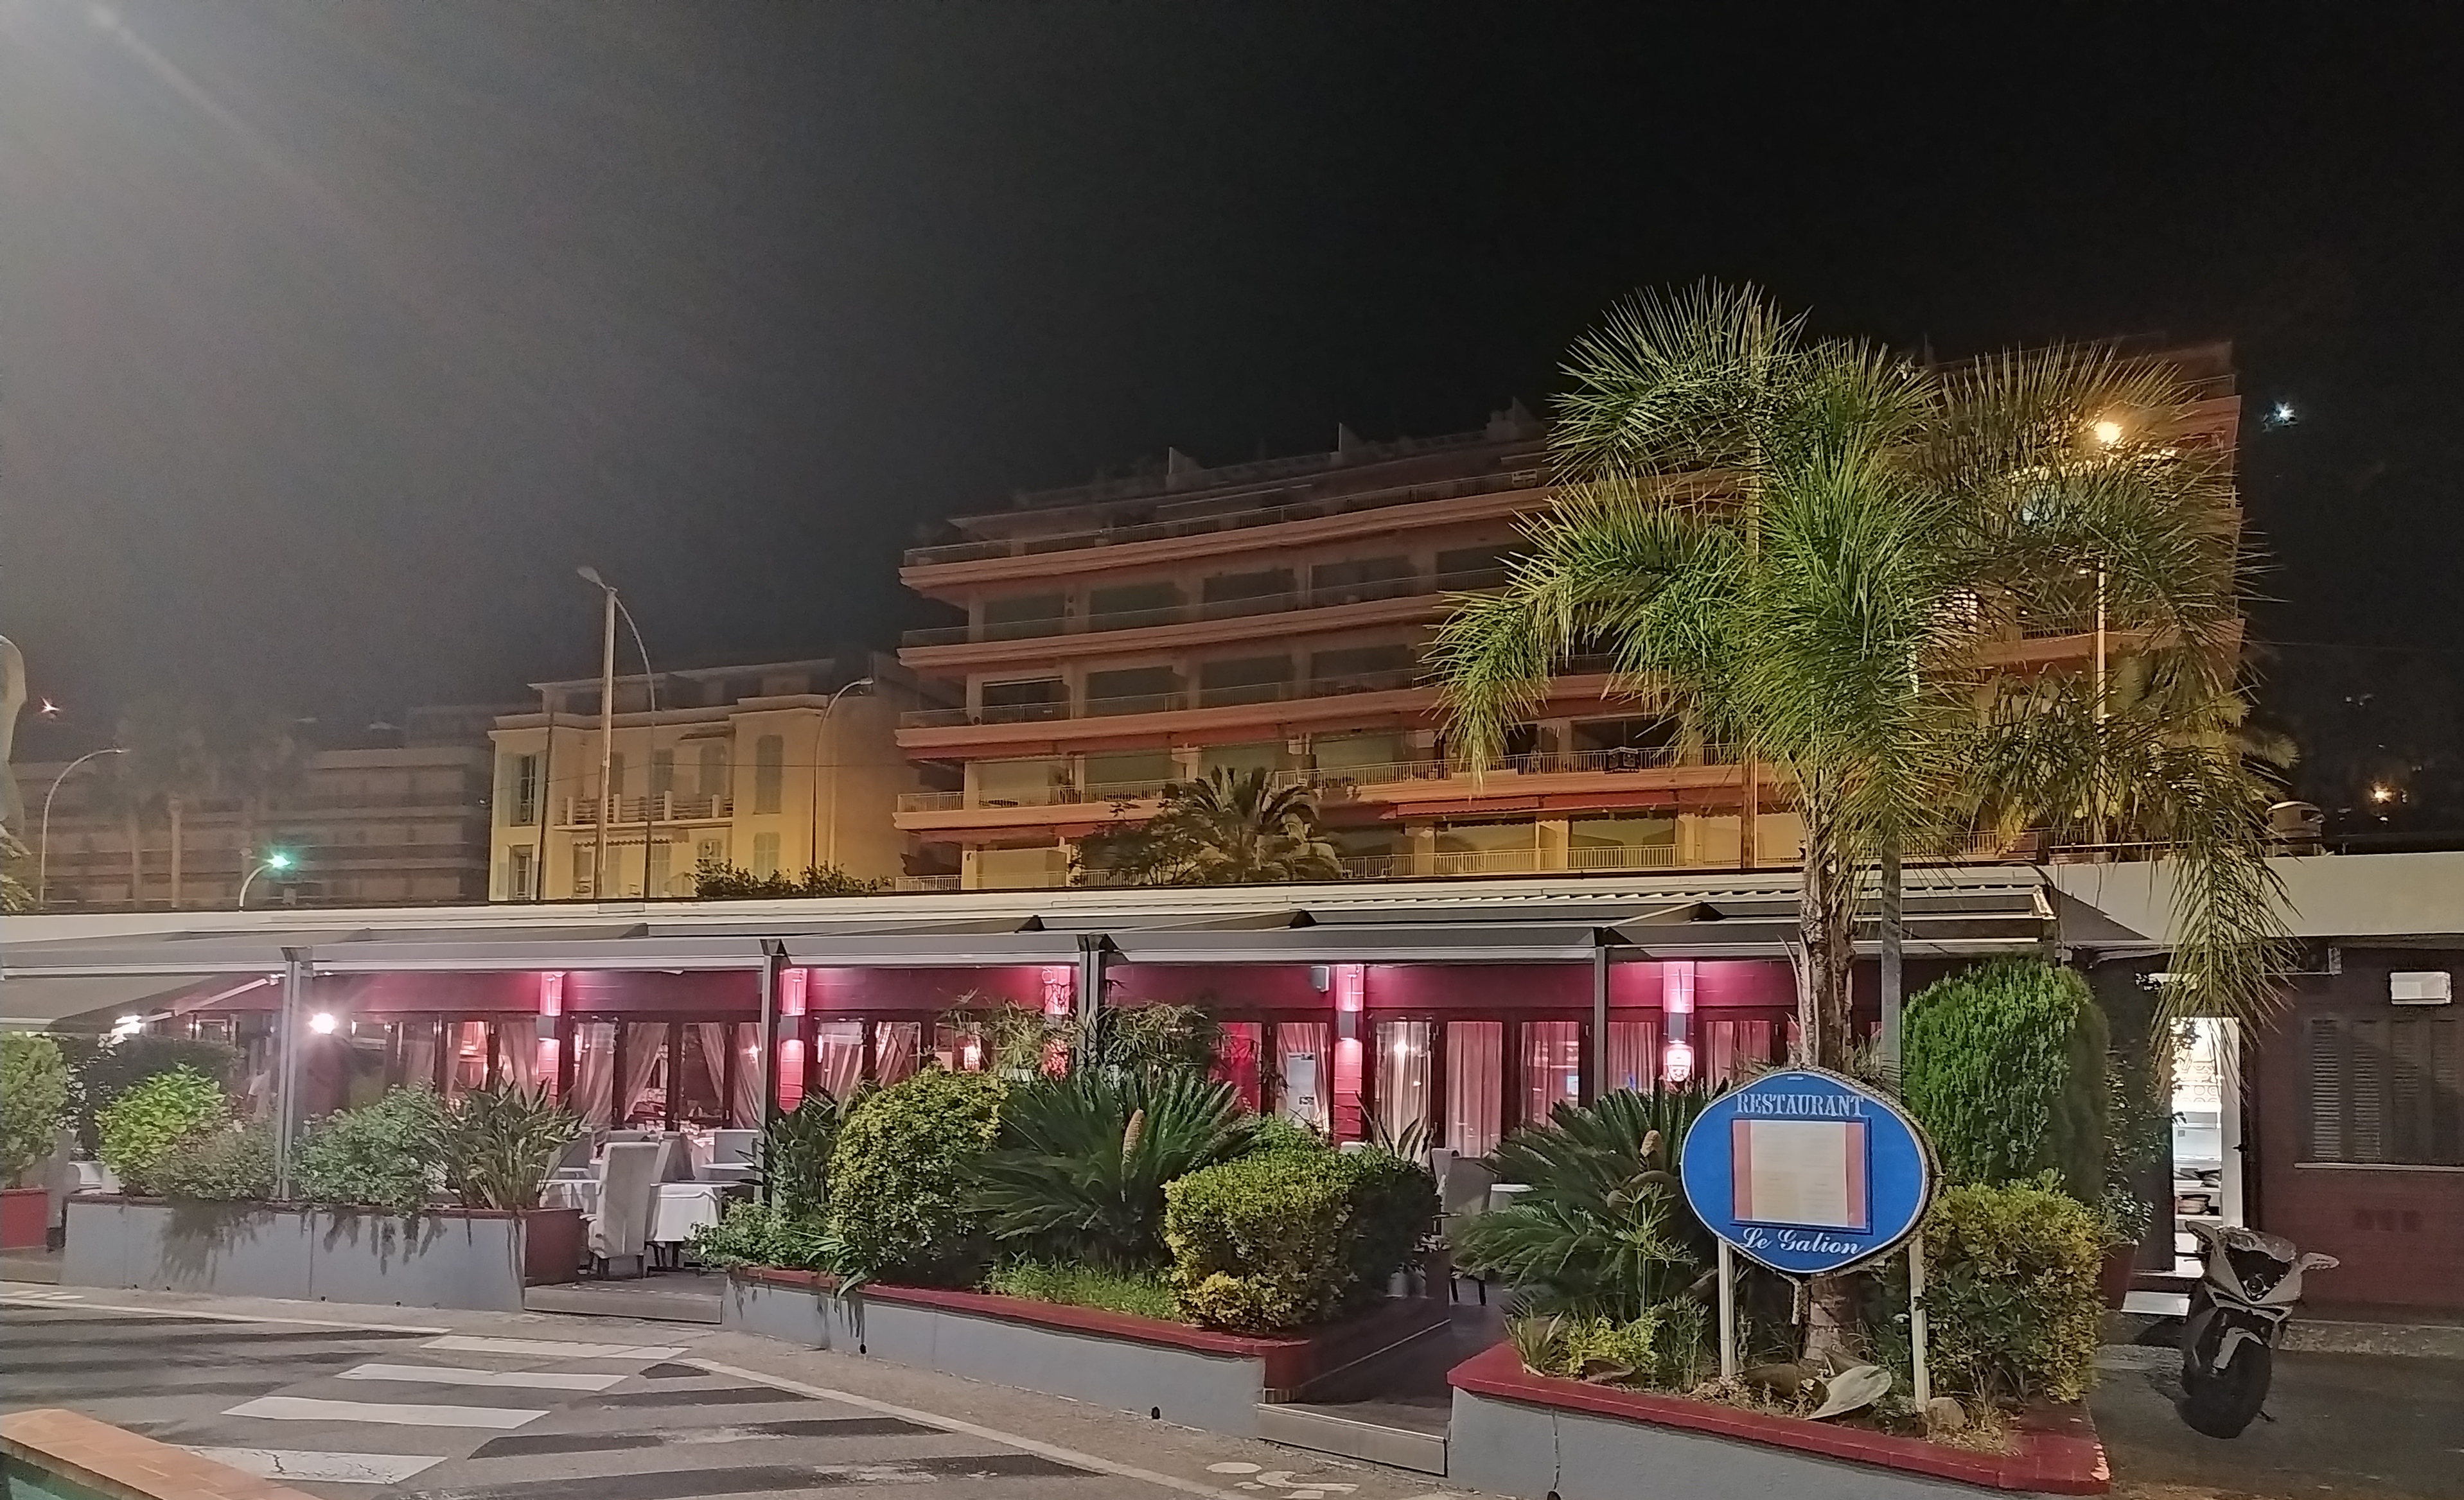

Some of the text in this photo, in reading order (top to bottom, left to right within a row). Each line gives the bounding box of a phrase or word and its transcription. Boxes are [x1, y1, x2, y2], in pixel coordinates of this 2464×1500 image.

[1736, 1094, 1864, 1117] RESTAURANT
[1738, 1227, 1863, 1255] Le Galion
